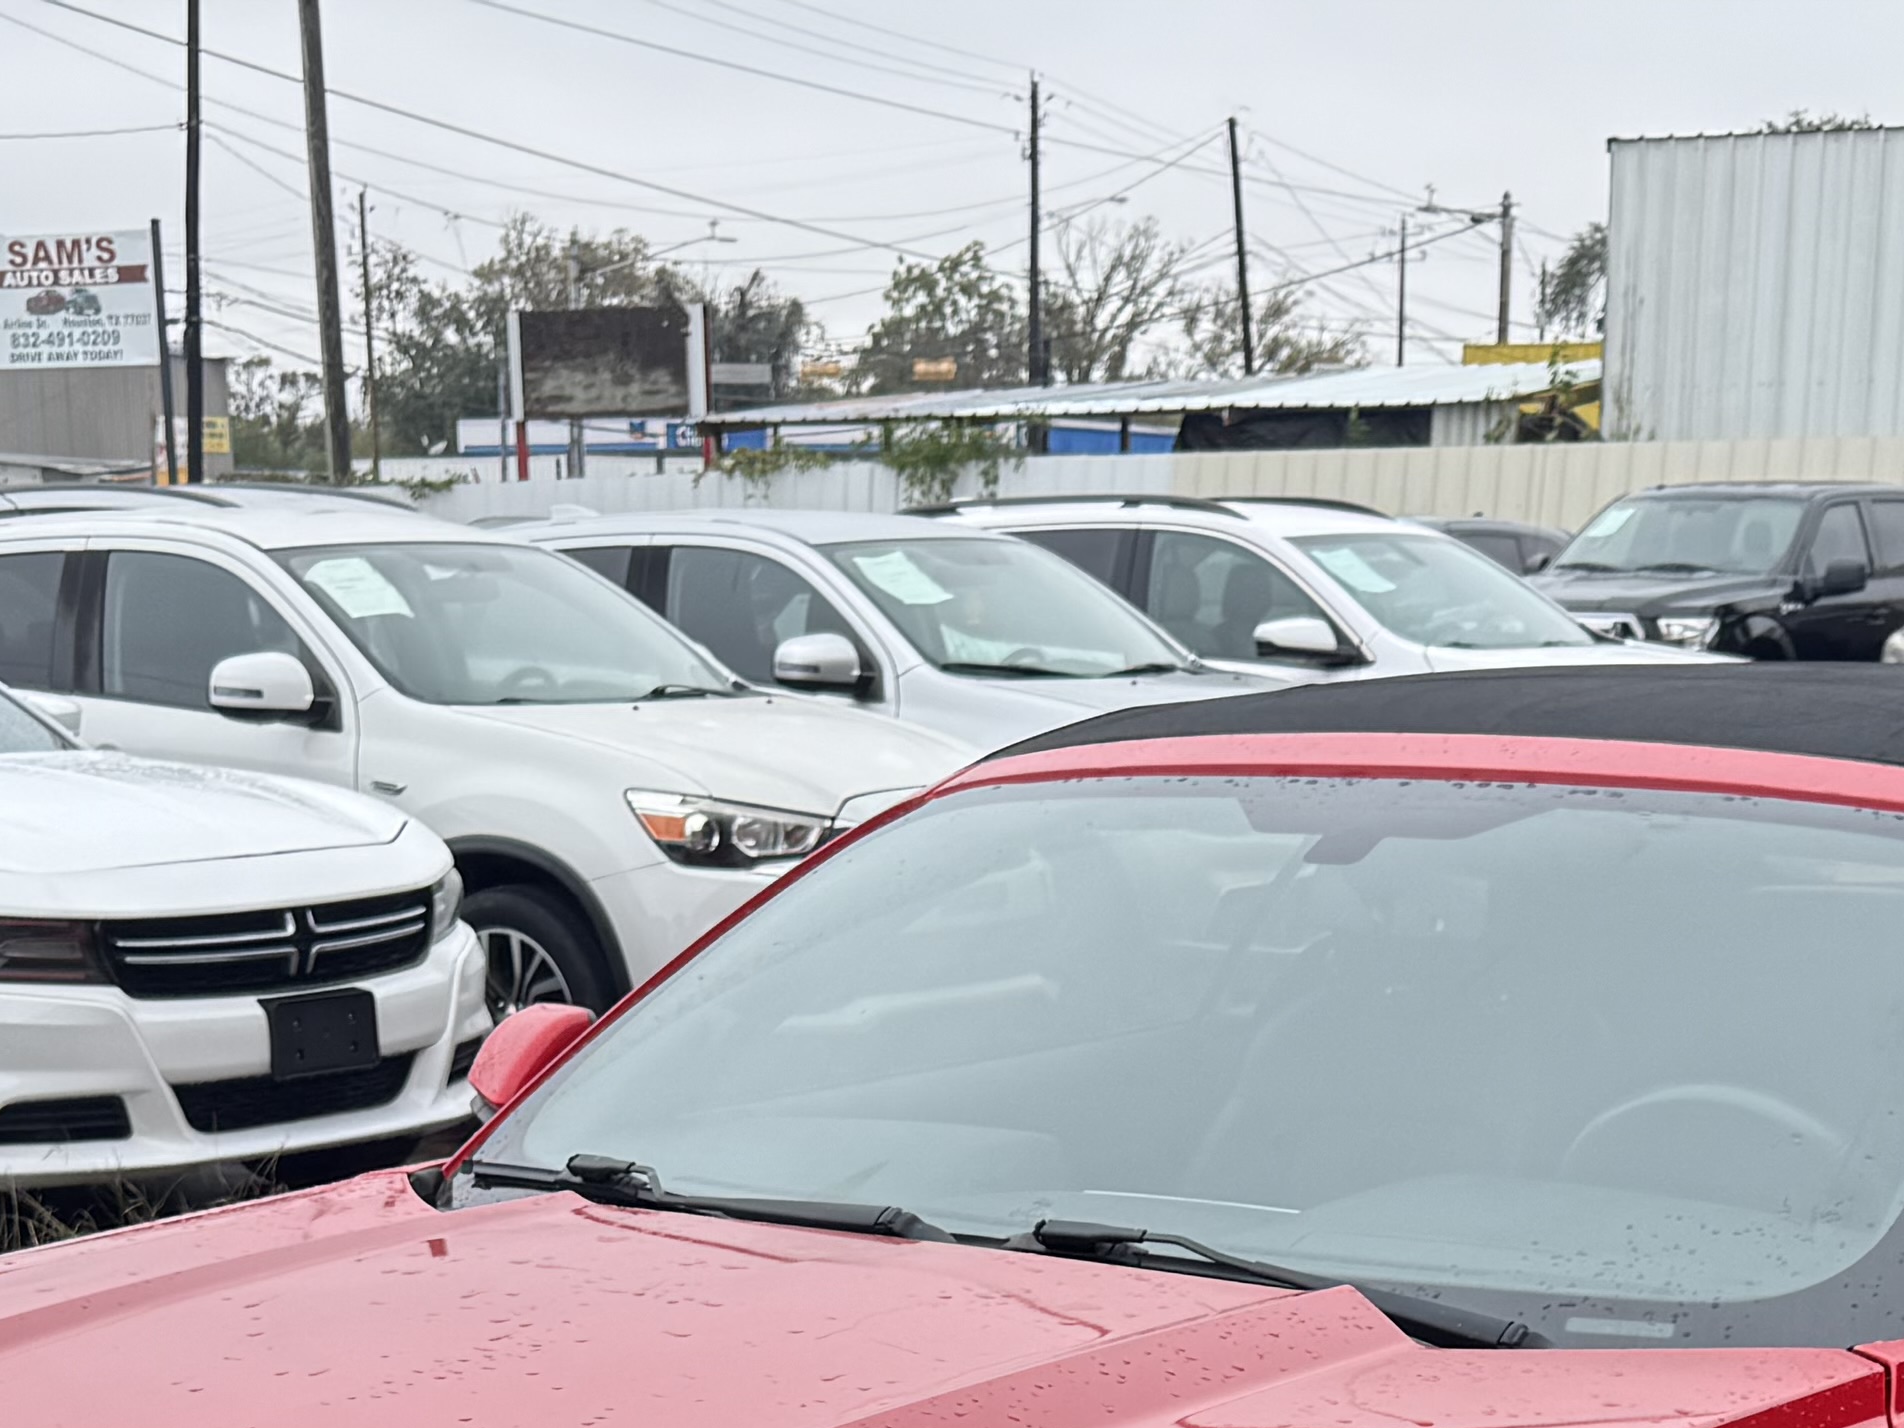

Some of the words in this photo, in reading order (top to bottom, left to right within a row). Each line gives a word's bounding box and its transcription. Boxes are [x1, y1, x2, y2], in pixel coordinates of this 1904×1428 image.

[8, 237, 116, 267] SAM'S
[2, 271, 54, 287] AUTO
[58, 267, 119, 285] SALES
[11, 330, 120, 349] 832-491-0209
[10, 352, 42, 363] DRIVE
[47, 351, 79, 362] AWAY
[81, 349, 123, 361] TODAY!
